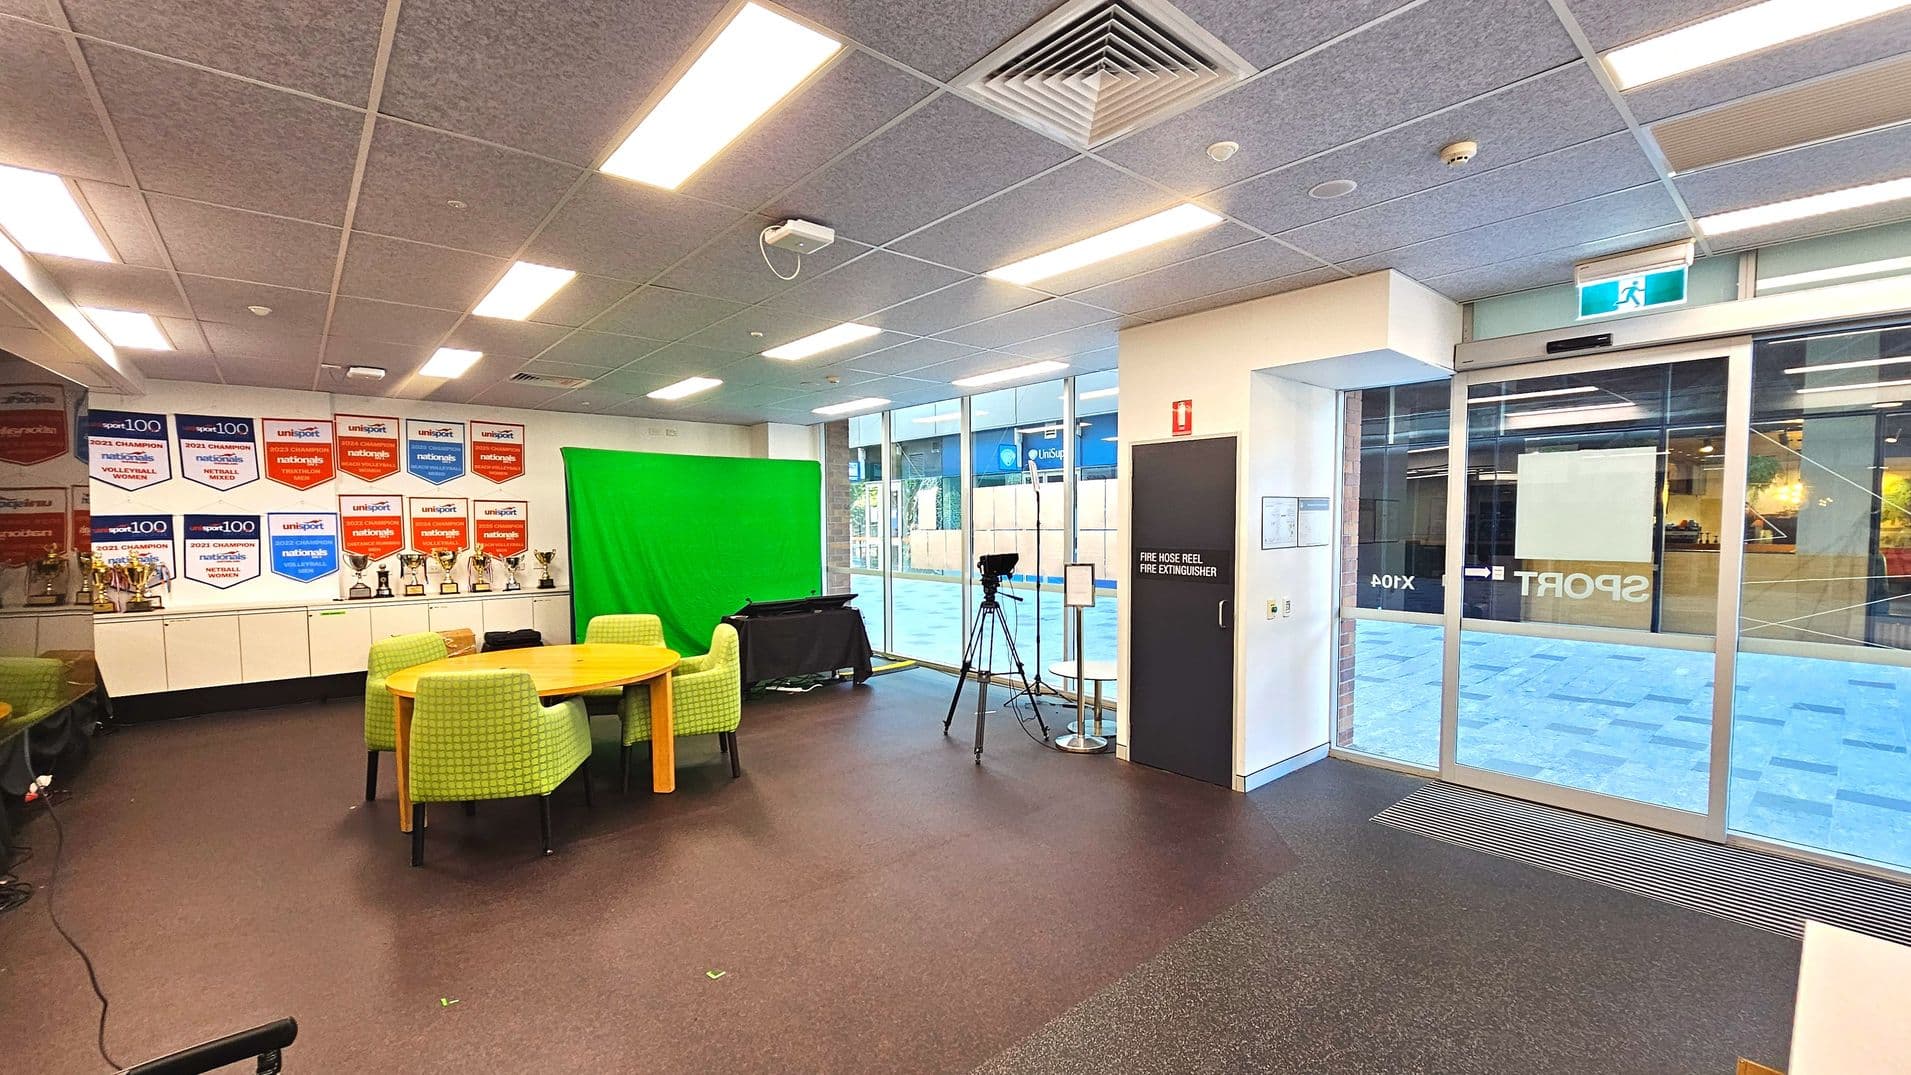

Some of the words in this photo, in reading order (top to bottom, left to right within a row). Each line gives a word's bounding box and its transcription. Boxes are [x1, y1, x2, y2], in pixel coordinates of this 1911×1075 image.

[277, 429, 320, 438] unisport
[348, 424, 387, 434] unisport
[418, 428, 454, 438] unisport
[481, 430, 514, 440] unisport
[115, 441, 163, 449] CHAMPION
[101, 451, 155, 462] nationals
[195, 453, 244, 463] nationals
[347, 449, 390, 459] nationals
[416, 453, 457, 462] nationals
[480, 453, 517, 463] nationals
[276, 455, 324, 465] nationals
[101, 467, 157, 475] VOLLEYBALL
[112, 473, 148, 481] WOMEN
[352, 503, 391, 512] unisport
[421, 506, 457, 514] unisport
[484, 509, 517, 517] unisport
[282, 522, 325, 531] unisport
[352, 528, 395, 537] nationals
[420, 529, 460, 538] nationals
[483, 531, 520, 539] nationals
[120, 543, 169, 551] CHAMPION
[198, 553, 247, 562] nationals
[281, 548, 329, 558] nationals
[107, 553, 160, 565] natinals
[1140, 552, 1157, 562] FIRE
[1159, 552, 1180, 563] HOSE
[1182, 553, 1203, 564] REEL
[1140, 563, 1157, 574] FIRE
[1159, 564, 1217, 577] EXTINGUISHER
